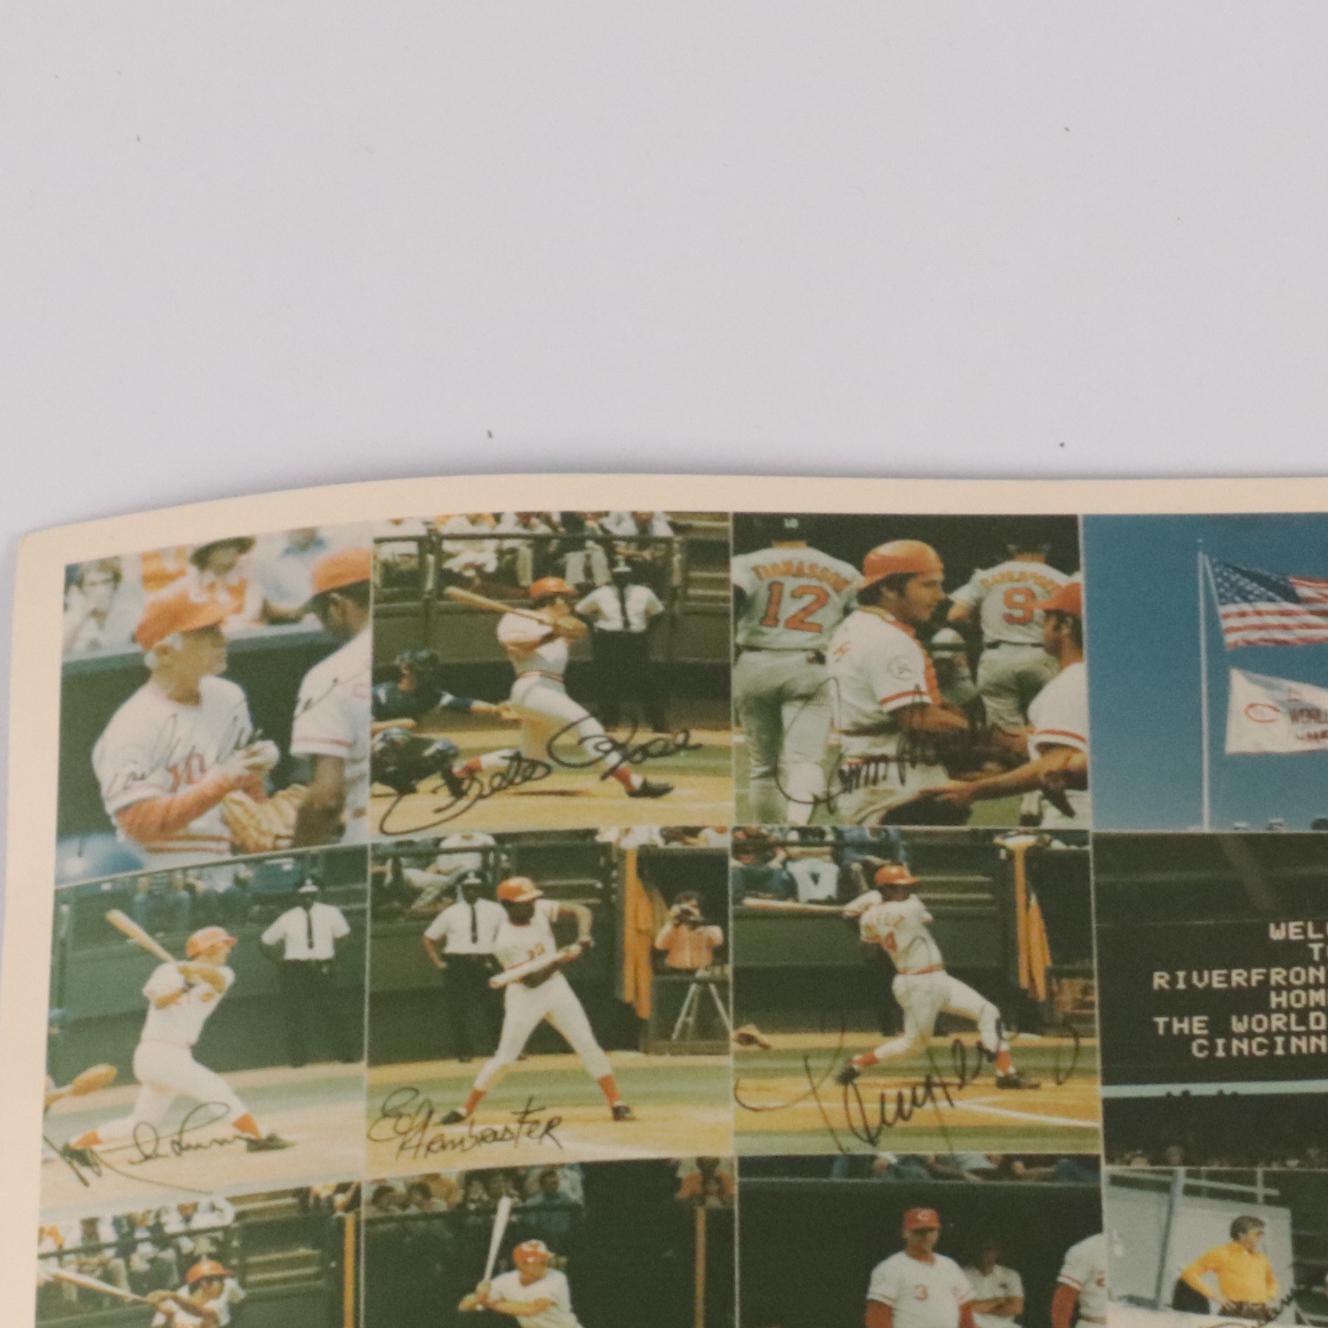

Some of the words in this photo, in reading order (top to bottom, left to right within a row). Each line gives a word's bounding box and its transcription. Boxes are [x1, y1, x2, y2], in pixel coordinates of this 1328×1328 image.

[759, 581, 829, 633] 12
[1002, 587, 1036, 625] 9
[1153, 1016, 1209, 1036] THE
[1231, 1012, 1327, 1034] WORLD
